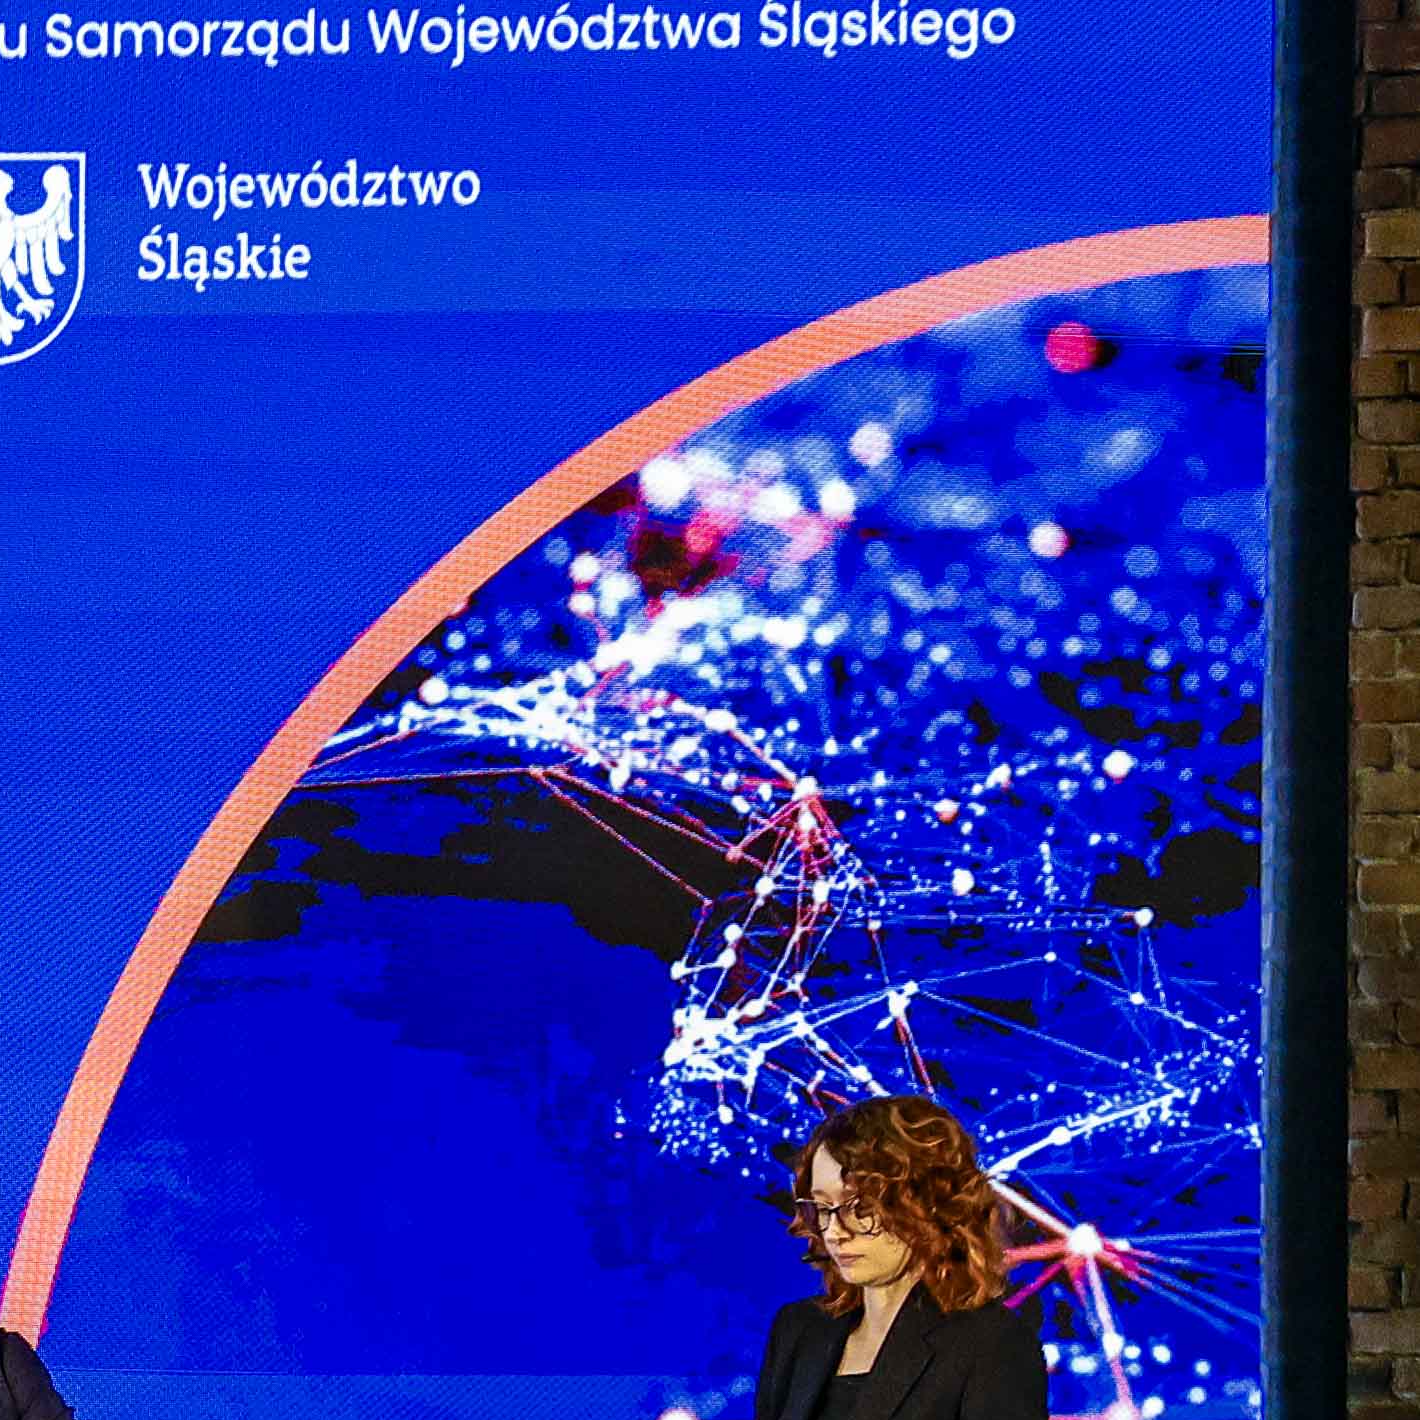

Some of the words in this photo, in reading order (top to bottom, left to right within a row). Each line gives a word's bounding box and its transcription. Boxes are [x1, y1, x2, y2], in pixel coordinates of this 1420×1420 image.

[45, 7, 350, 68] Samorządu
[367, 3, 741, 68] Województwa
[137, 158, 481, 222] Województwo
[137, 223, 312, 294] Śląskie
